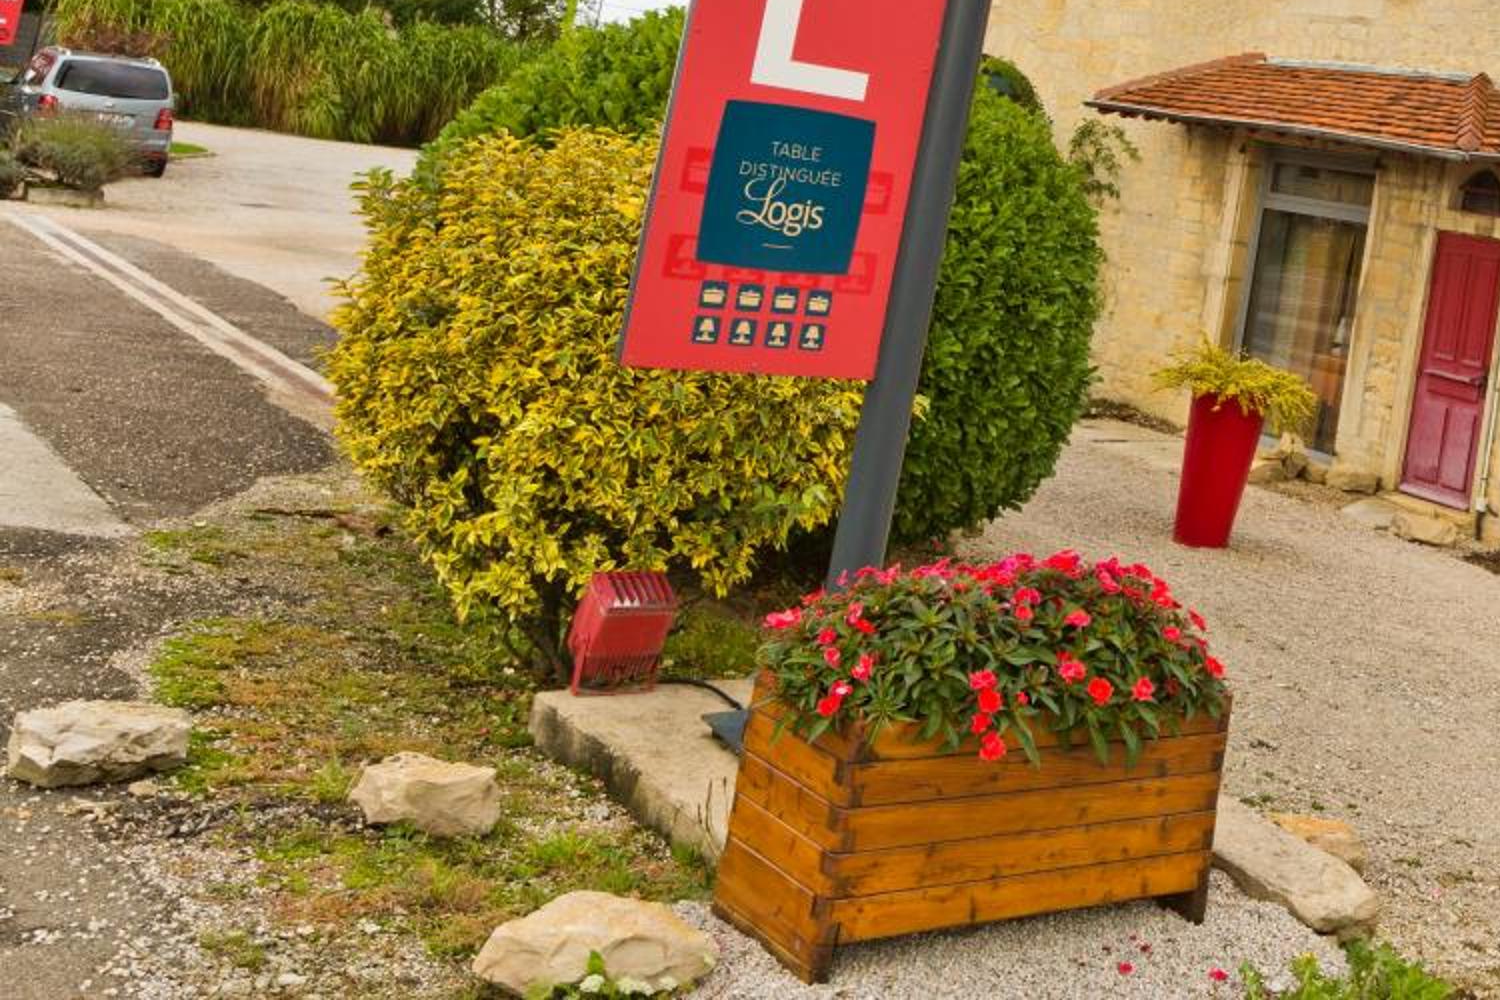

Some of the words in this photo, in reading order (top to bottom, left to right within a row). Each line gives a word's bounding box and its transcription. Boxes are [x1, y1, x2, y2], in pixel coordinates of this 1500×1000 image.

[772, 141, 823, 162] TABLE
[738, 160, 843, 187] DISTINGUÉE
[736, 174, 825, 237] Logis
